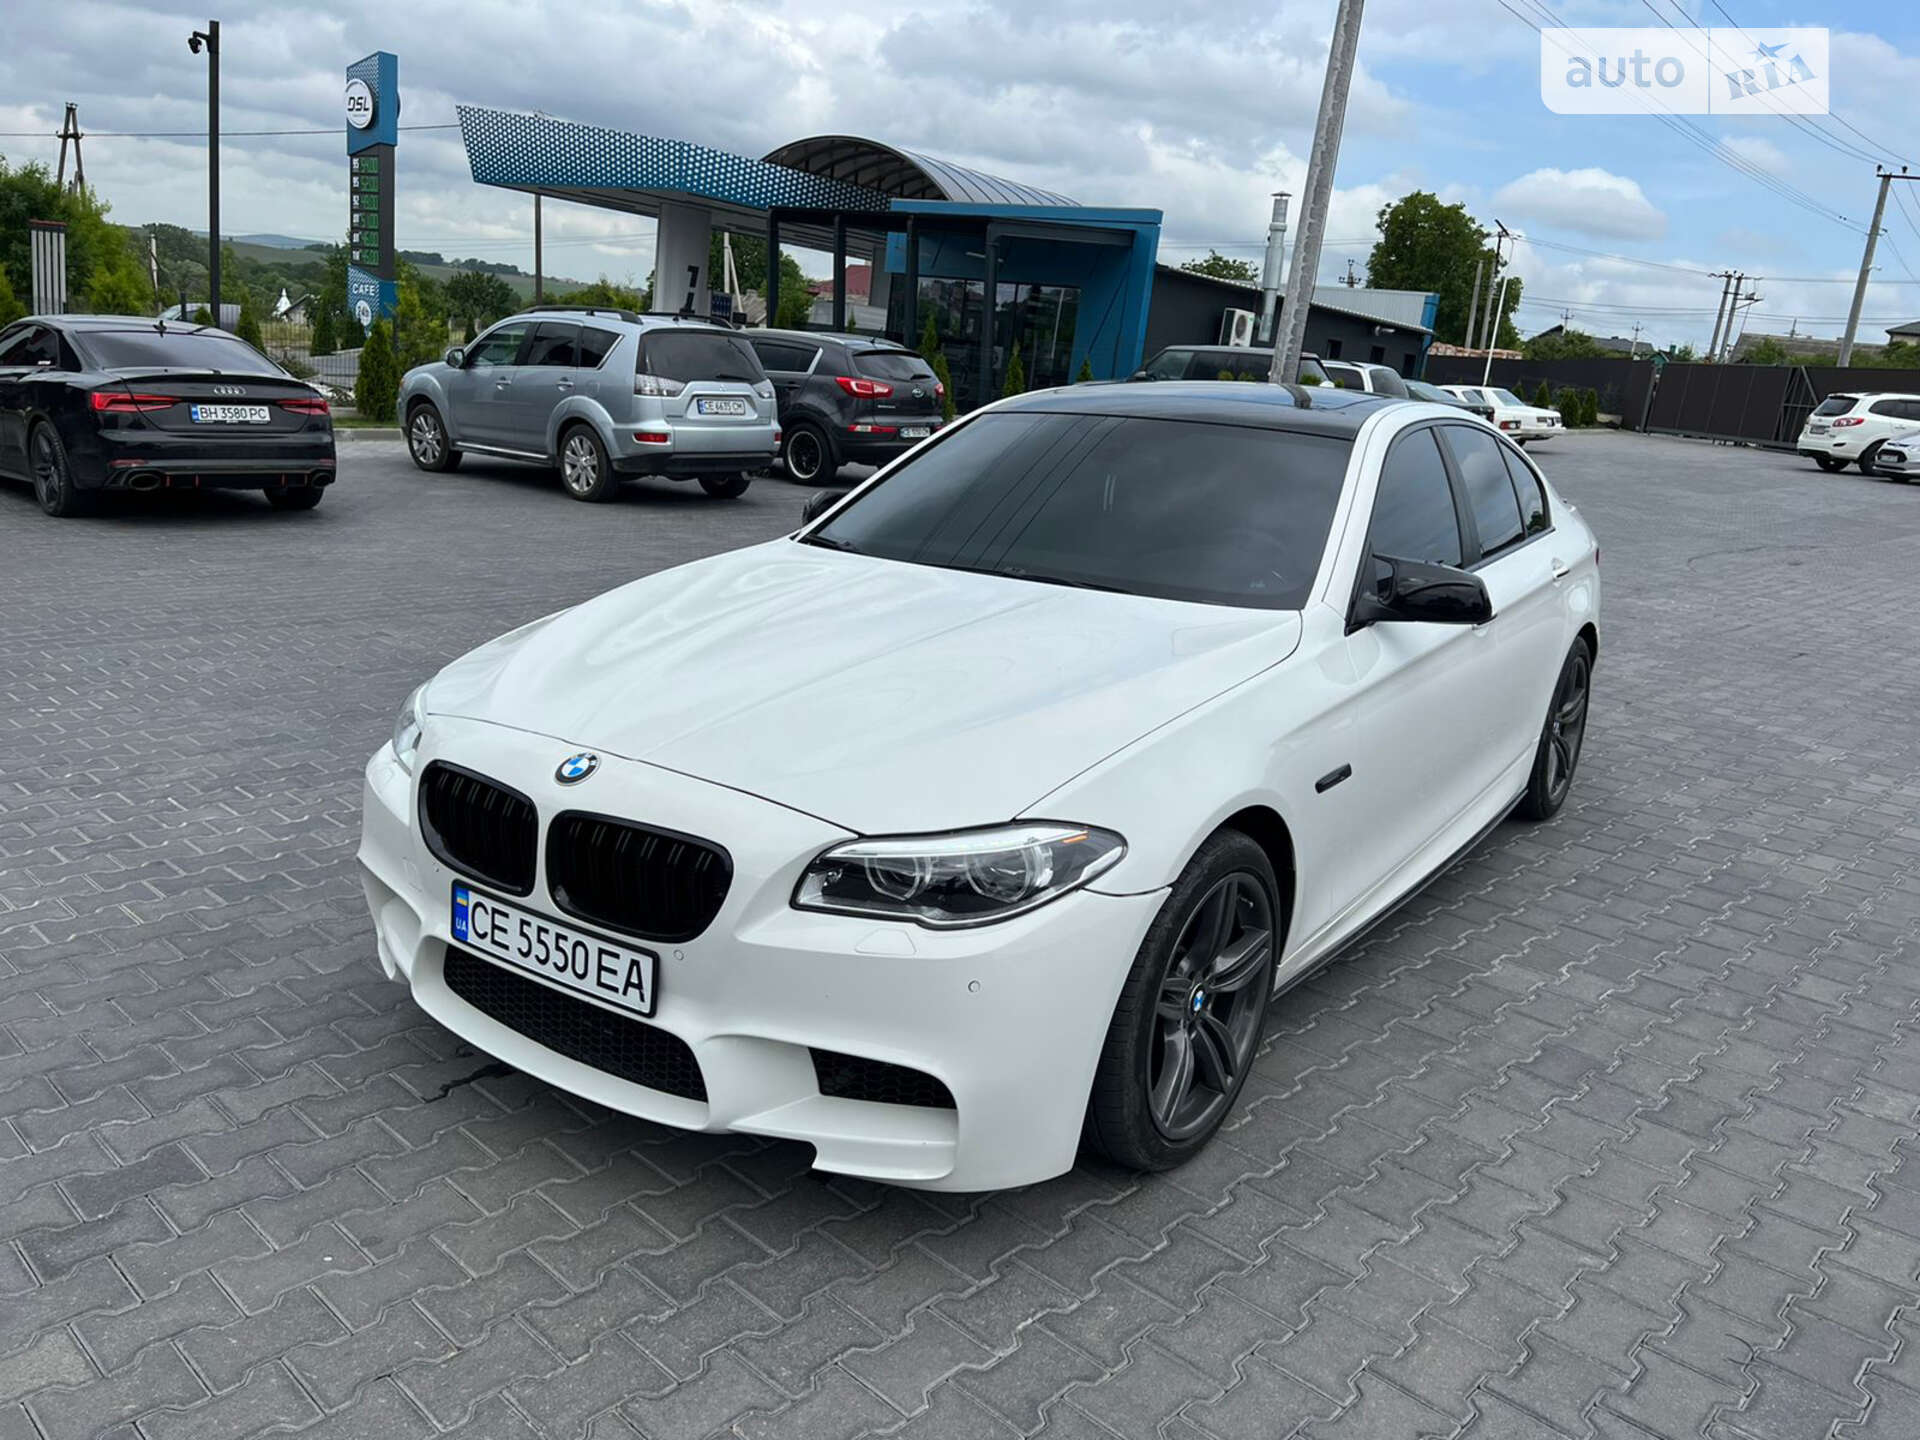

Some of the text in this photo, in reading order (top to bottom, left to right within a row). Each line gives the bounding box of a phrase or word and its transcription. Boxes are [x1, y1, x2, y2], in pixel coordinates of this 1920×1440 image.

[347, 96, 370, 112] DSL
[352, 283, 376, 296] CAFE
[199, 407, 267, 419] BH 3580 PC
[455, 917, 468, 932] UA
[471, 901, 646, 1003] CE 5550 EA
